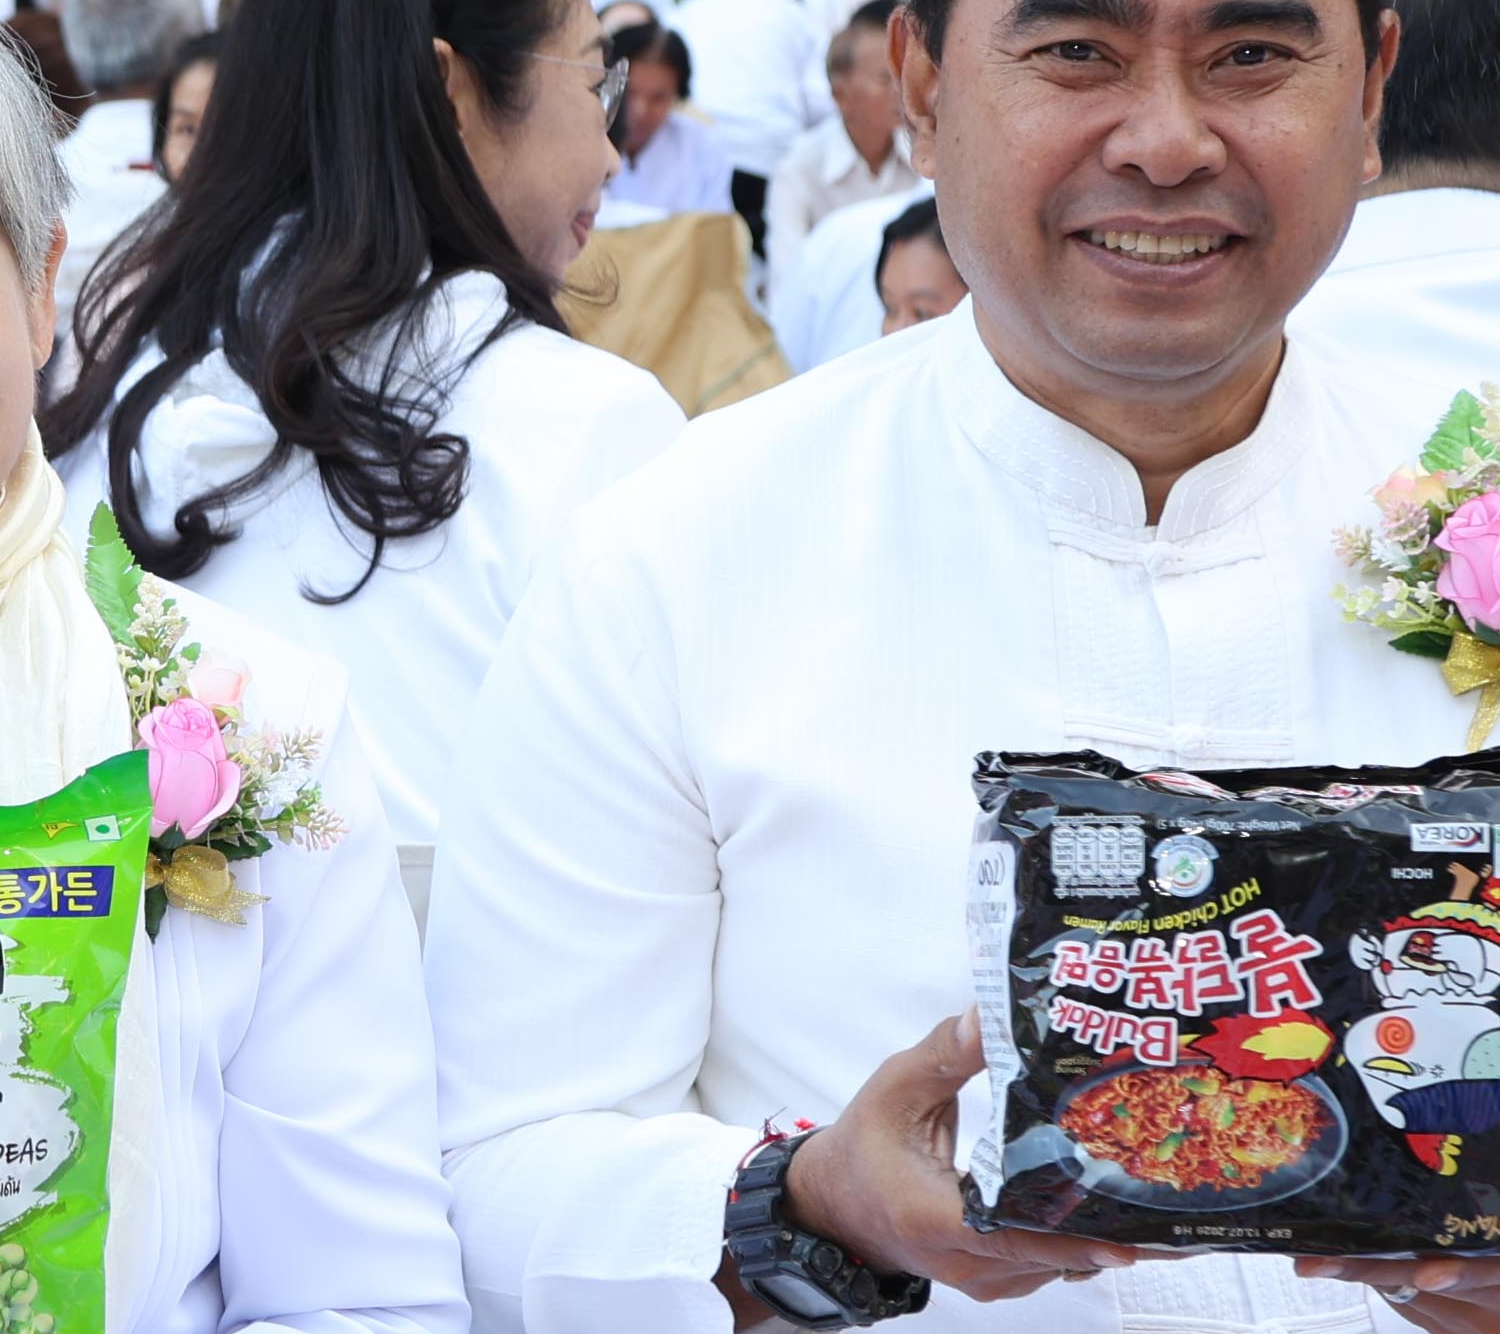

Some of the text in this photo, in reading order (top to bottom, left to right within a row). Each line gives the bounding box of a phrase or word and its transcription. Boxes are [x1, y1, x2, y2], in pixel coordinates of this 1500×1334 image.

[1416, 826, 1484, 844] KOREA
[1391, 868, 1433, 879] HOCHI
[1063, 880, 1262, 934] HOT Chicken Flavor Ramen
[1051, 910, 1323, 1017] 불닭볶음면
[1050, 997, 1177, 1065] Buldak
